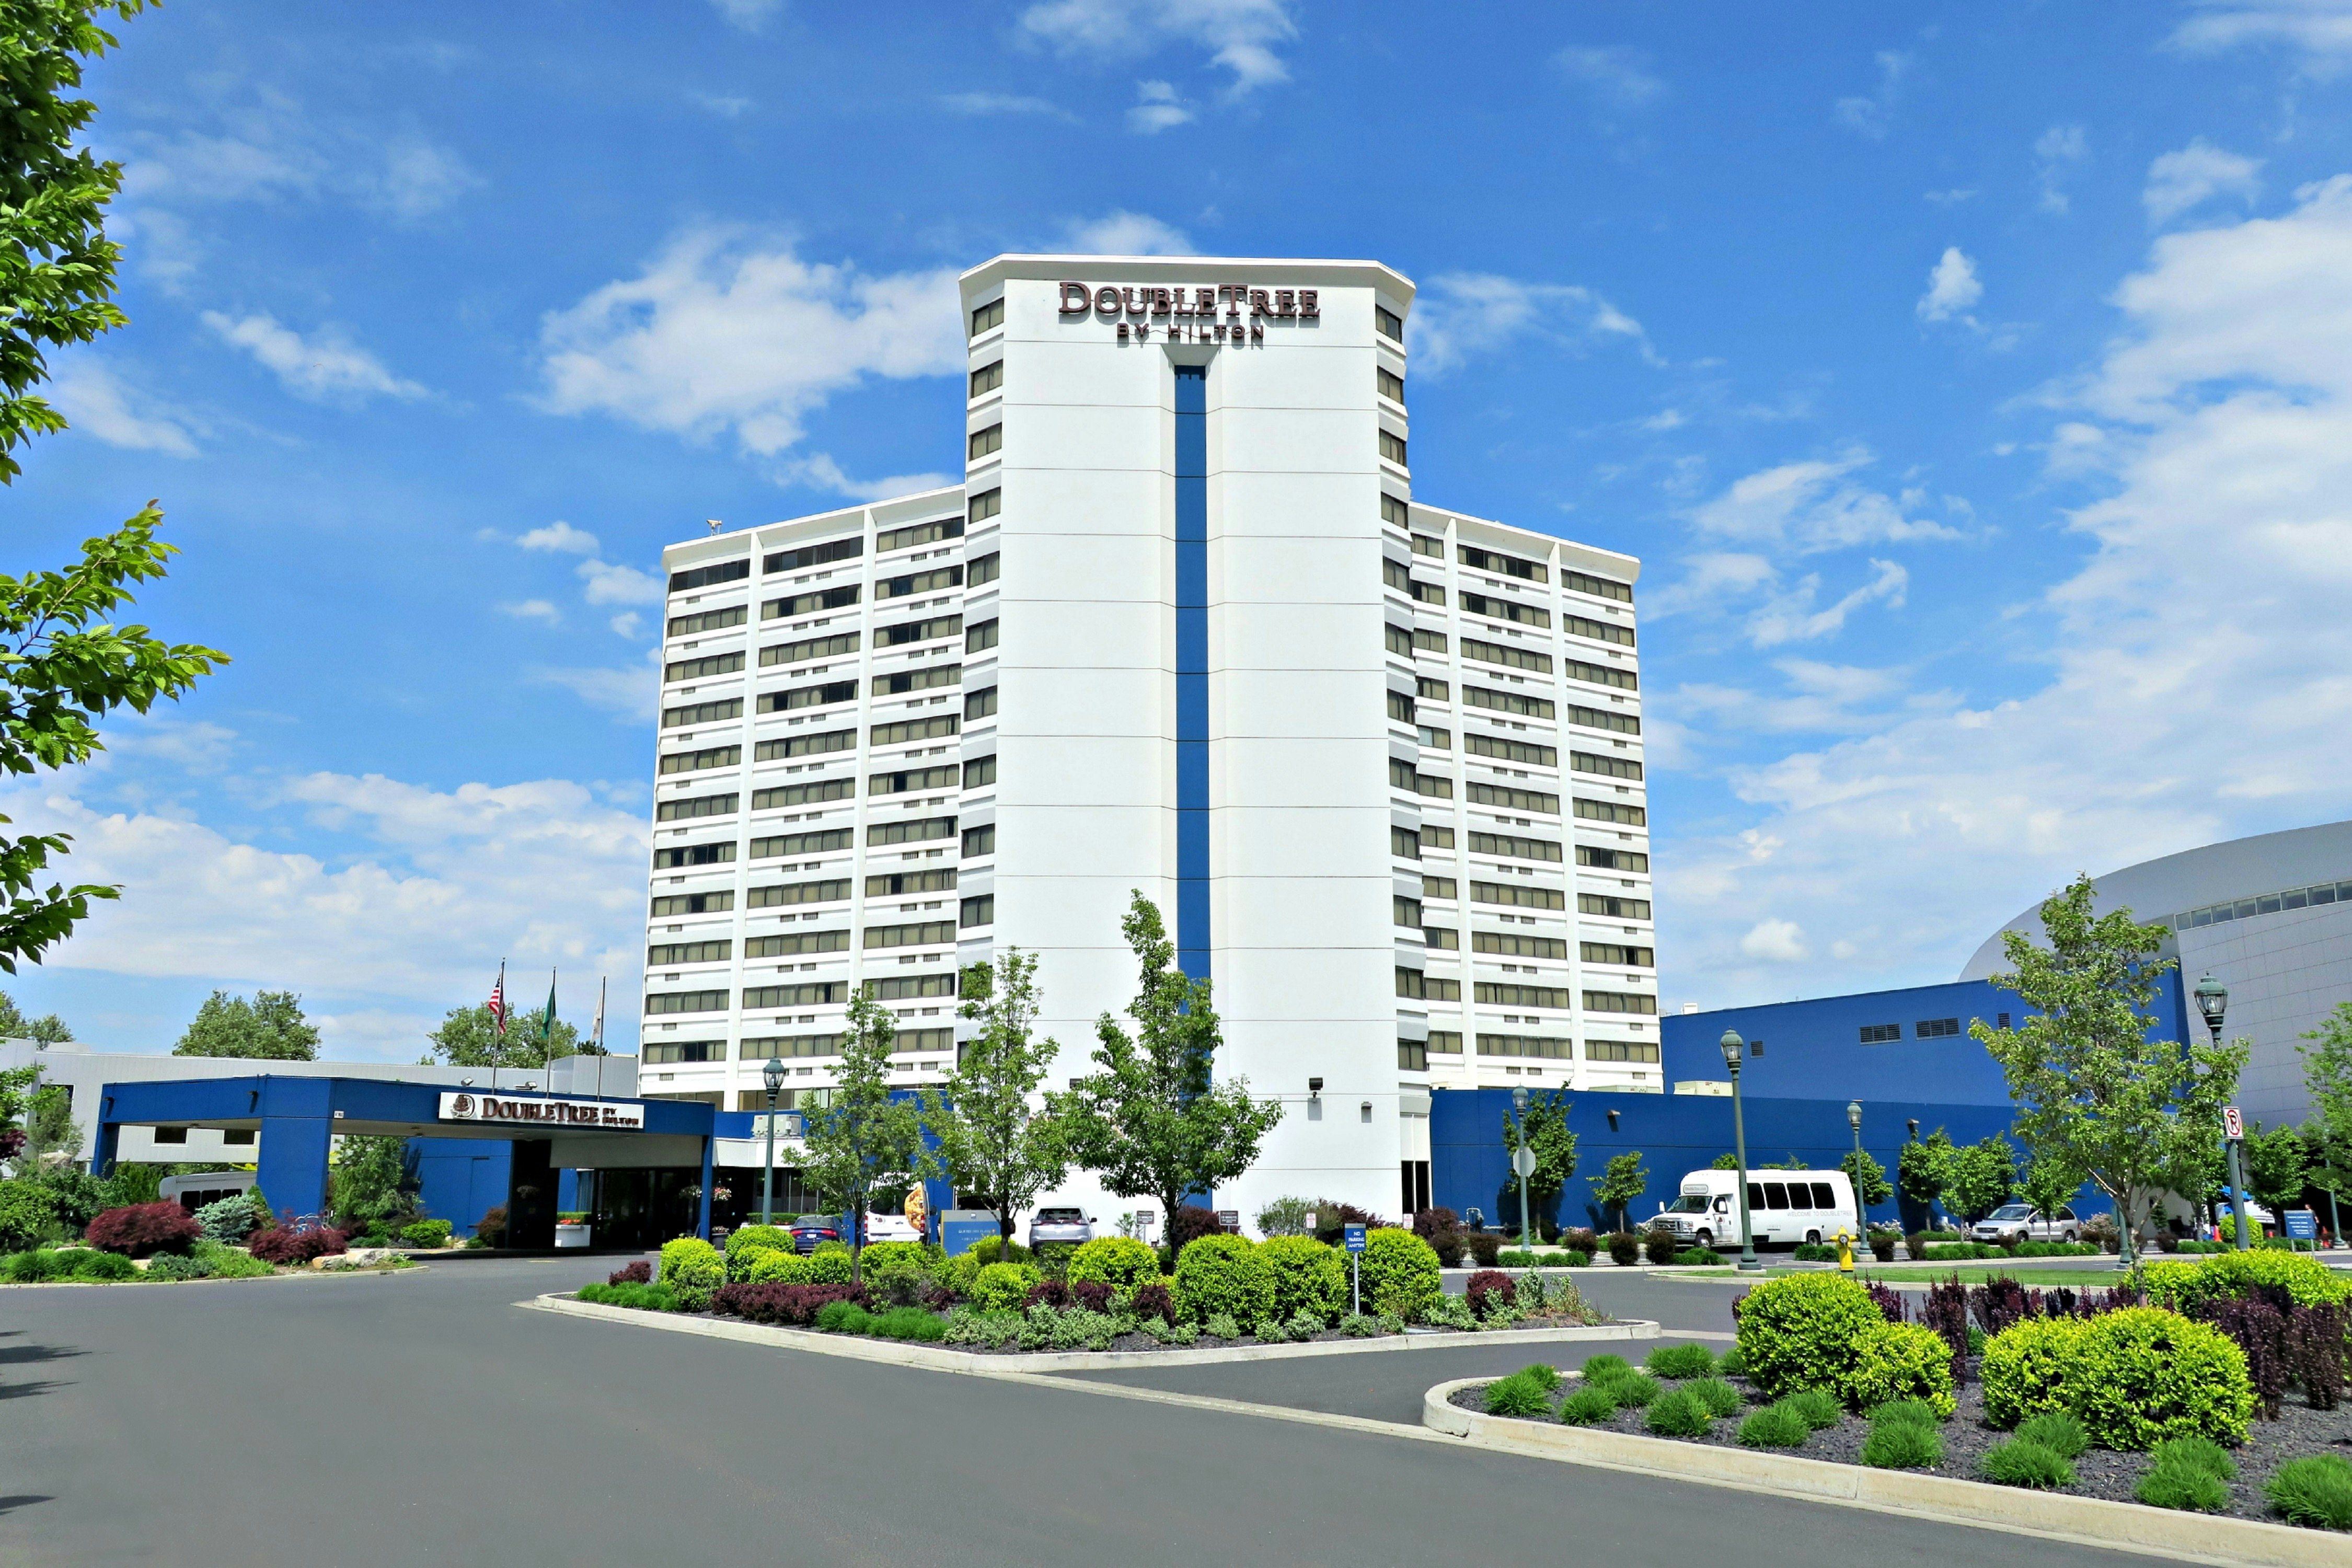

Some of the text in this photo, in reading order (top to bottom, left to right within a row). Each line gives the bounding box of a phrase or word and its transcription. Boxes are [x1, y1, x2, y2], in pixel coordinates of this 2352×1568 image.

[1058, 282, 1320, 318] DOUBLETREE
[1117, 323, 1263, 339] BY HILTON
[481, 1098, 599, 1123] DOUBLETREE
[602, 1116, 639, 1125] HILTON
